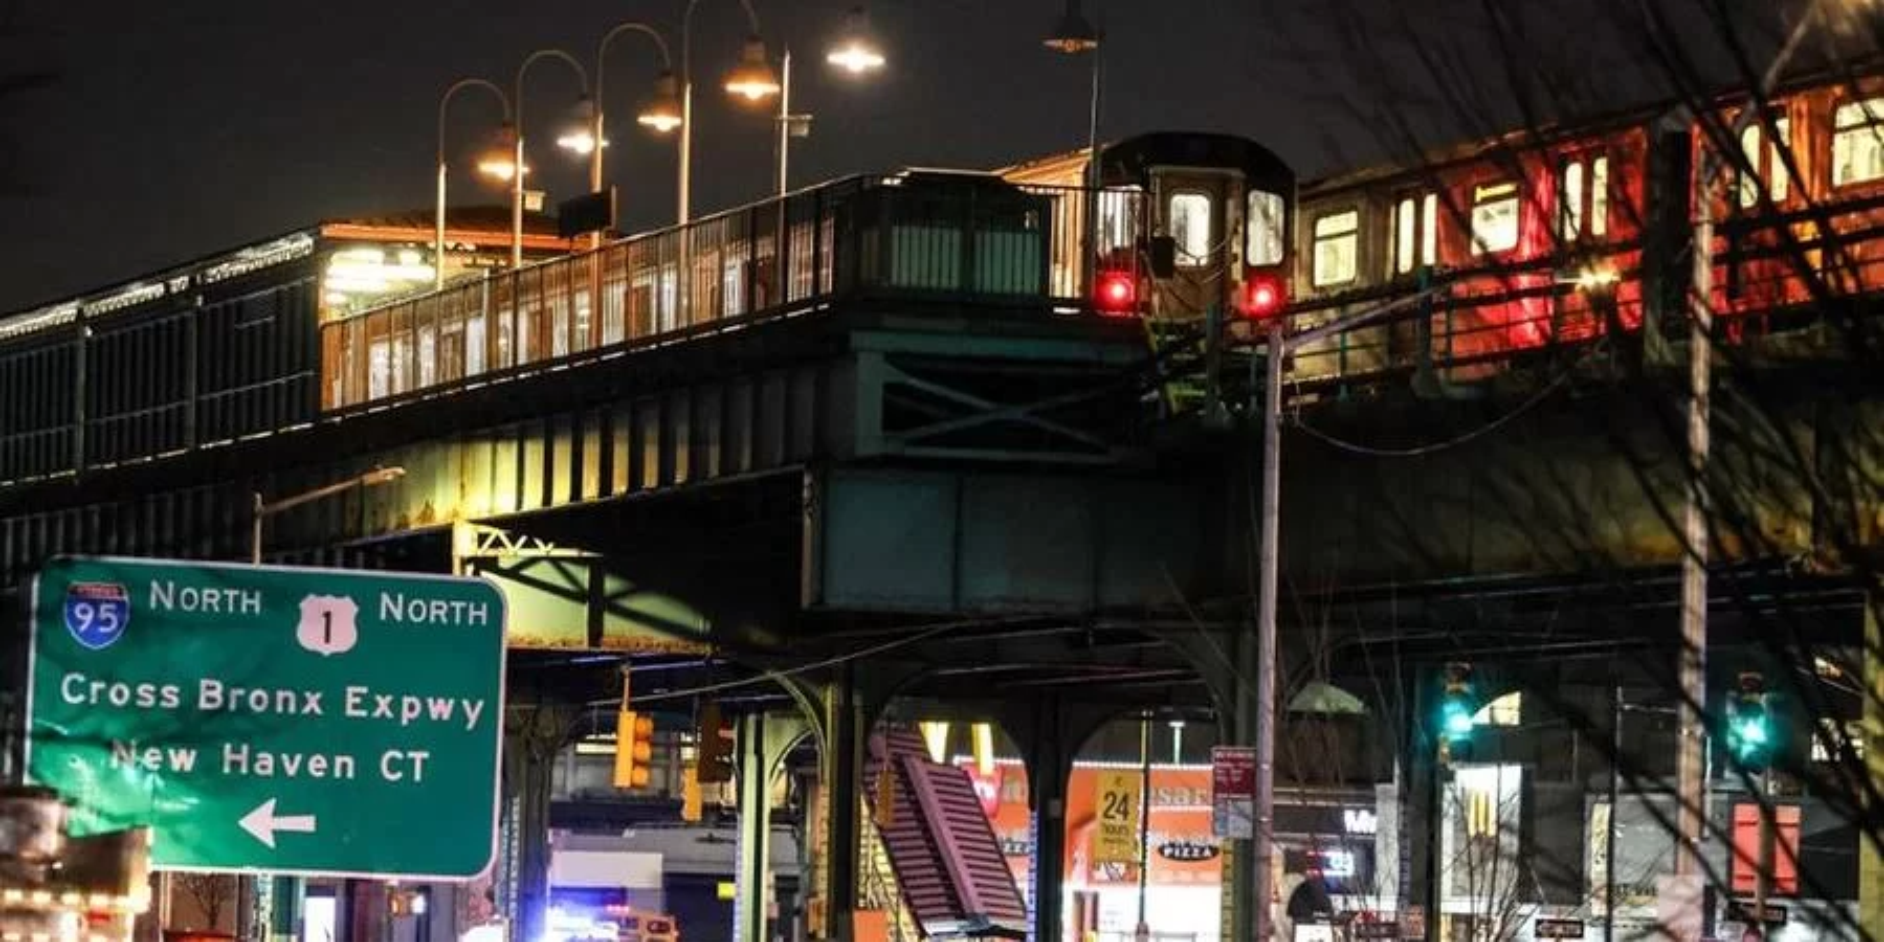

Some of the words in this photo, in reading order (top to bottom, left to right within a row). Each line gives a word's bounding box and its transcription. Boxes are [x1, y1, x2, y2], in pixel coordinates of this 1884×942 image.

[150, 581, 261, 614] NORTH
[380, 593, 488, 626] NORTH
[74, 602, 118, 633] 95
[321, 610, 333, 644] 1
[61, 673, 180, 708] Cross
[199, 679, 323, 715] Bronx
[345, 686, 484, 730] Expwy
[110, 739, 197, 773] New
[222, 744, 355, 778] Haven
[380, 750, 430, 782] CT
[1103, 790, 1130, 820] 24
[1163, 845, 1213, 858] PIZZA
